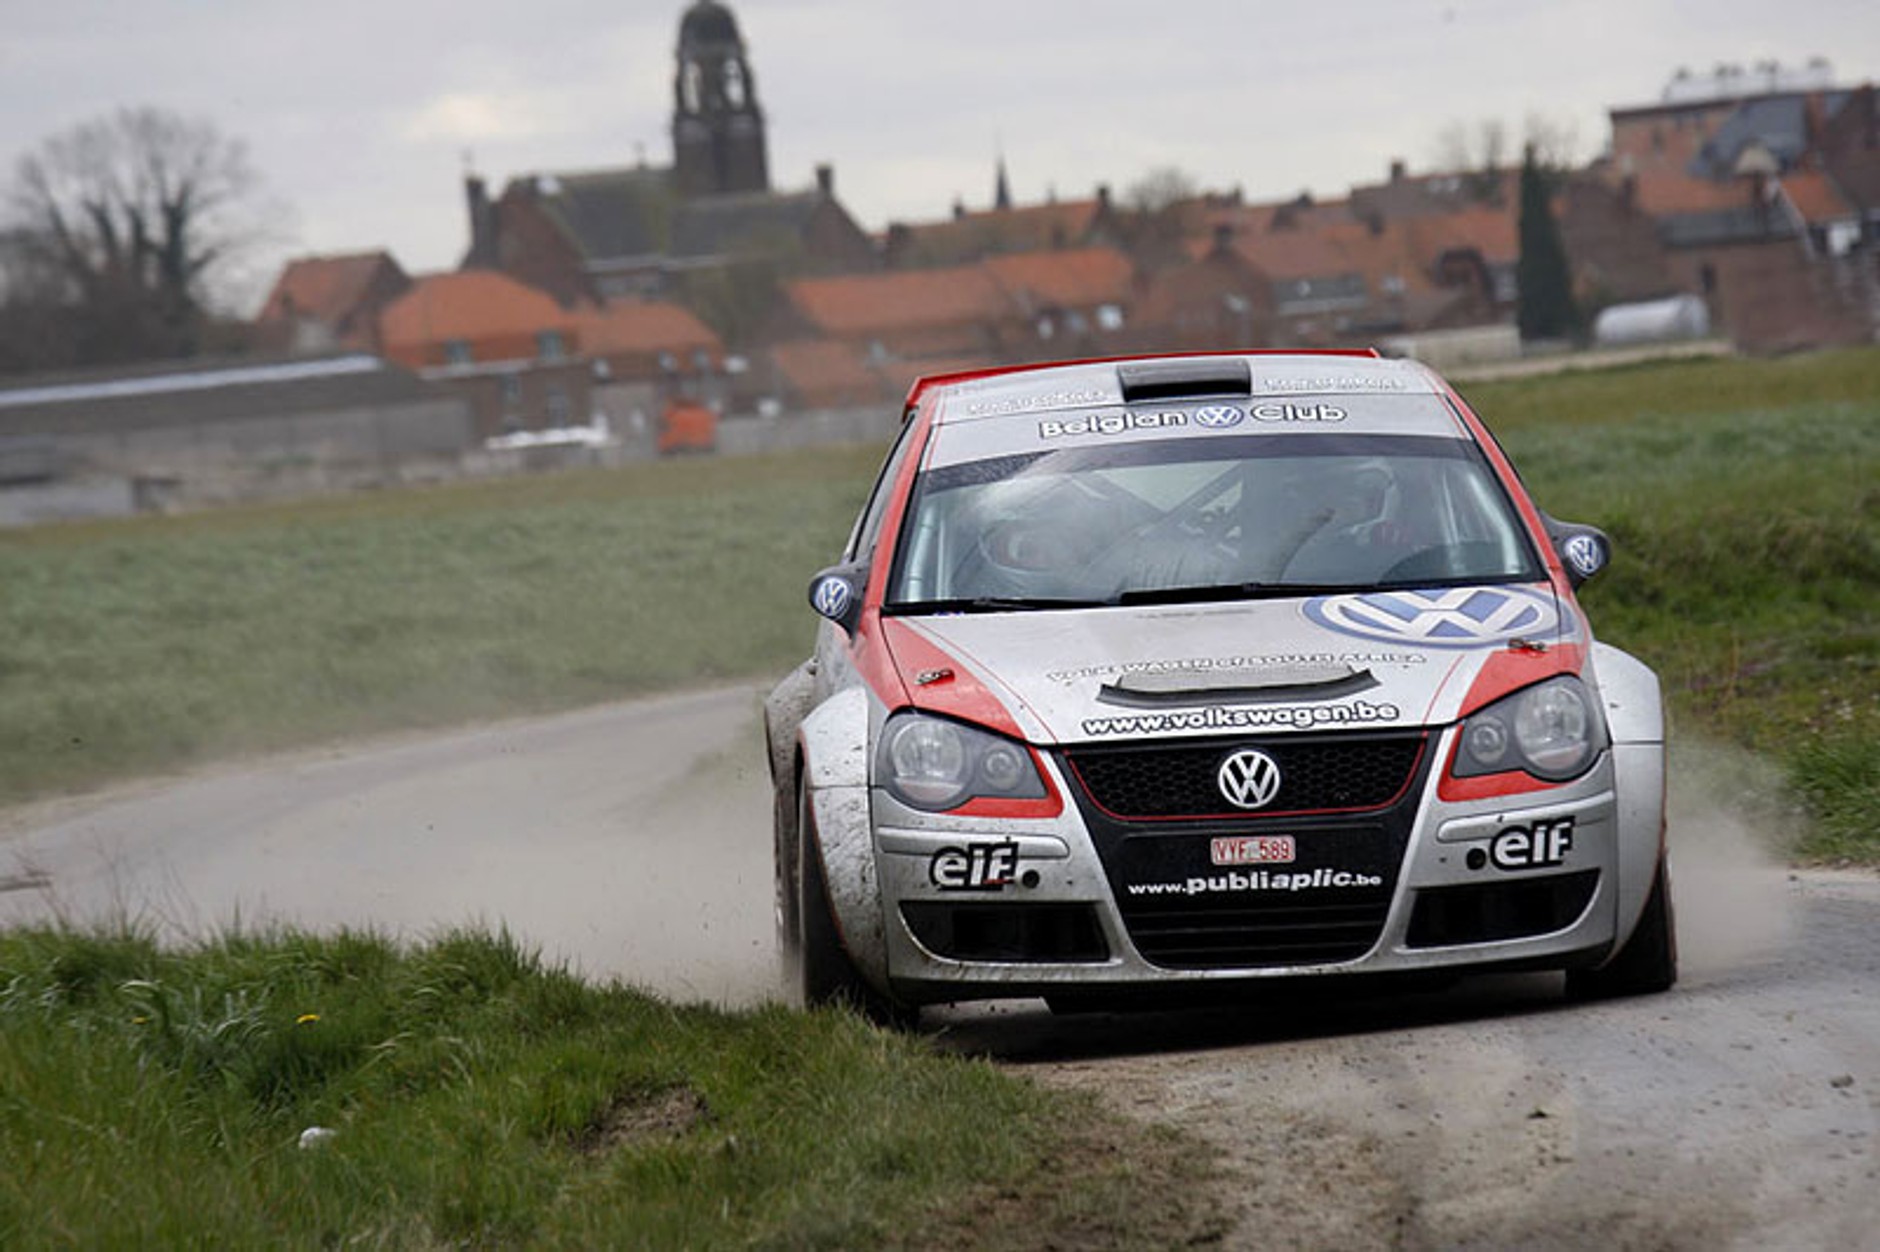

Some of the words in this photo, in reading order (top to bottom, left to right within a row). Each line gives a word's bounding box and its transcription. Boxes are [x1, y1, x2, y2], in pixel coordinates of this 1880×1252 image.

[1038, 408, 1188, 438] Belgian
[1250, 403, 1347, 422] Club
[1082, 701, 1400, 736] www.volkswagen.be
[1258, 837, 1291, 860] 589
[1490, 815, 1576, 871] elf
[1127, 867, 1383, 896] www.publiaplic.be
